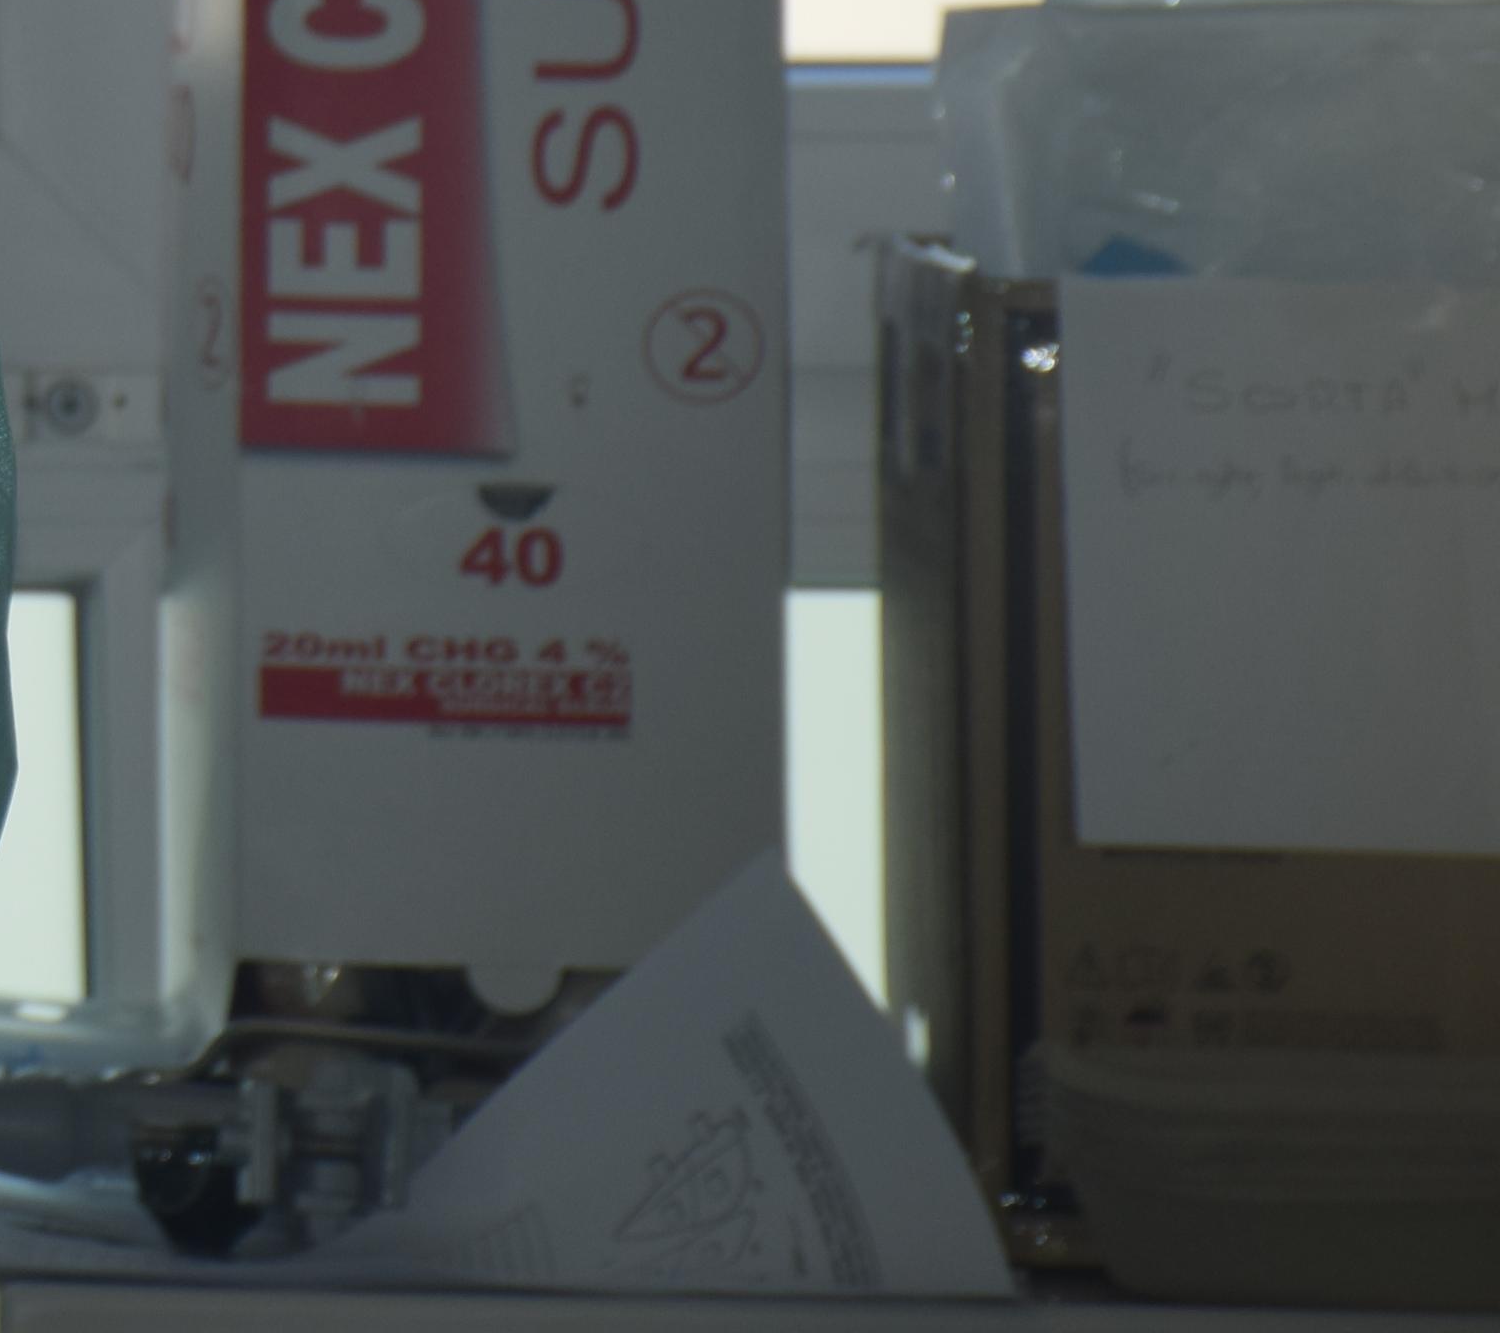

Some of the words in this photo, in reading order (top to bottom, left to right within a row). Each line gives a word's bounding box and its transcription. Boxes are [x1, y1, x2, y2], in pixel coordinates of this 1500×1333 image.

[267, 115, 424, 409] NEX
[458, 524, 563, 589] 40
[261, 629, 387, 662] 20ml
[404, 633, 519, 664] CHG
[535, 637, 566, 665] 4
